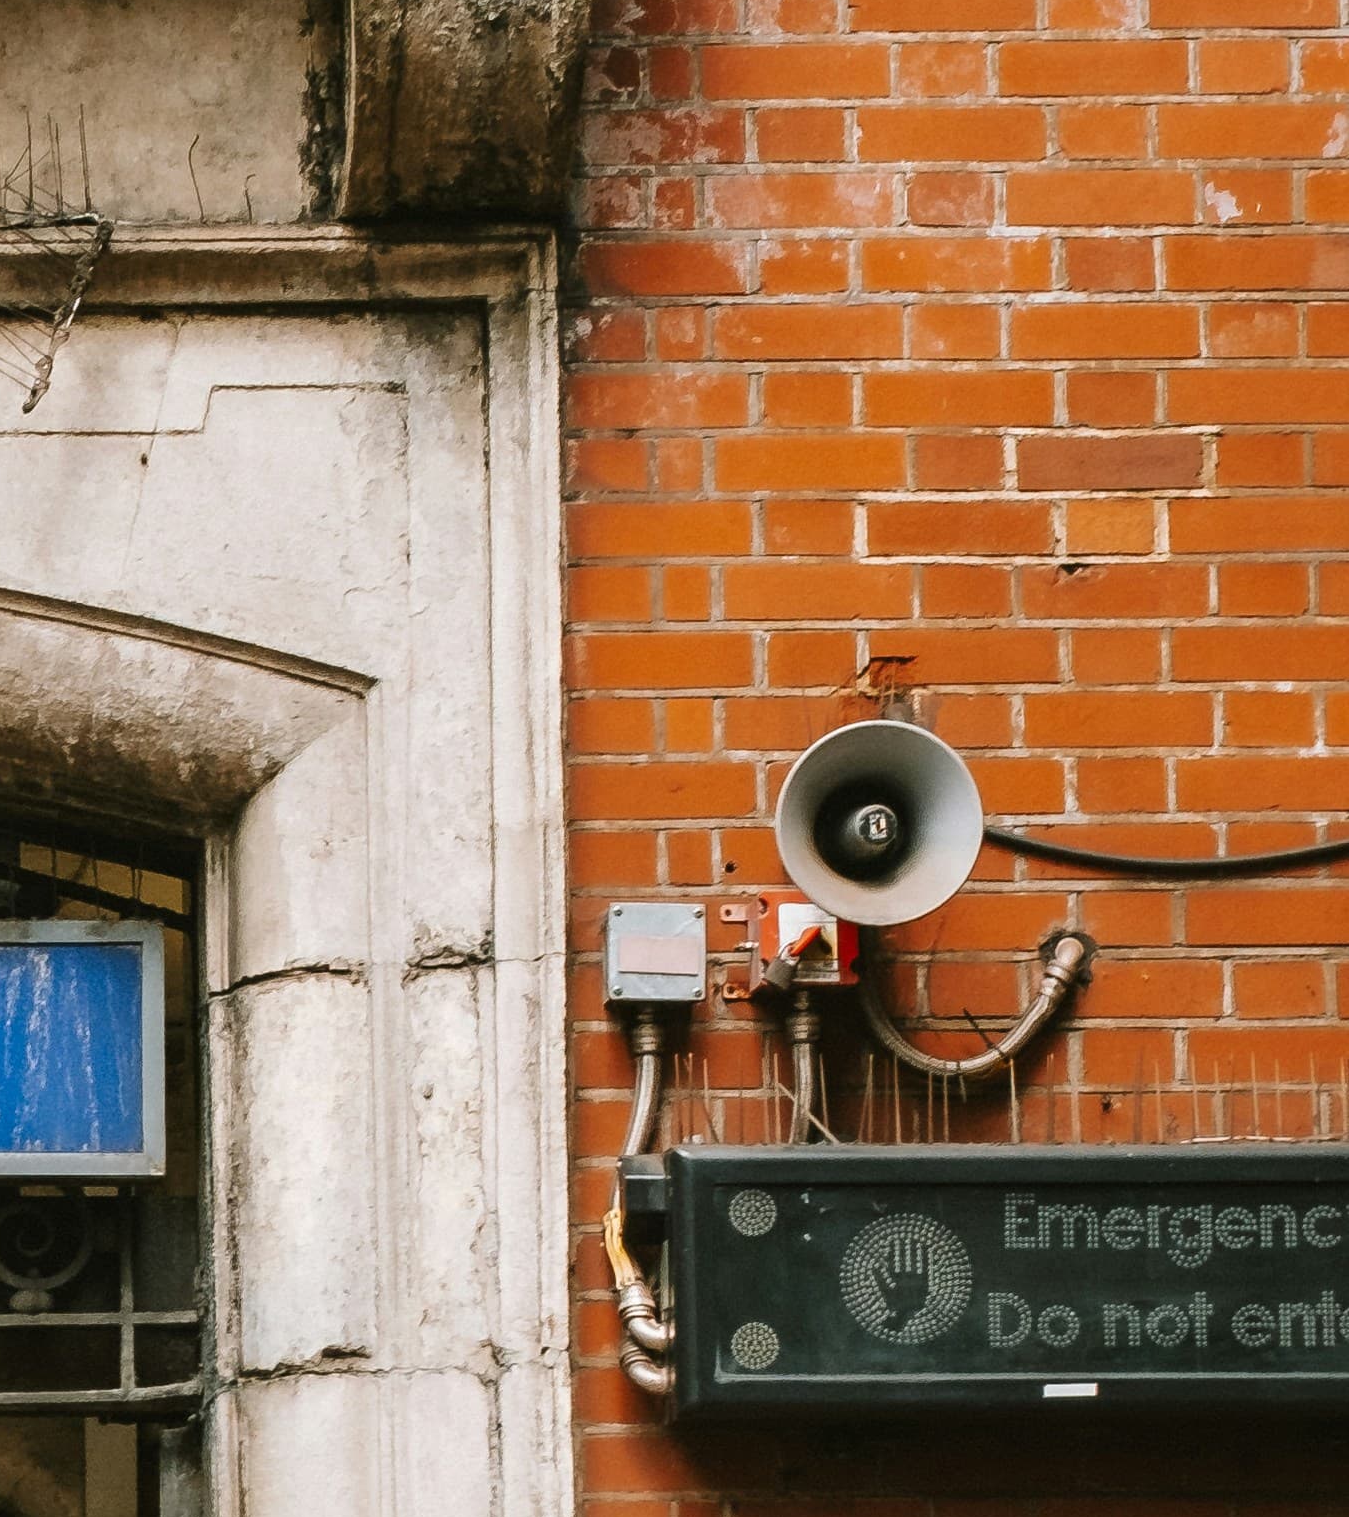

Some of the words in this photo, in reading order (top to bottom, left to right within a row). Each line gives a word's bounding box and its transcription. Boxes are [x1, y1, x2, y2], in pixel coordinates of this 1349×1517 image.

[1004, 1193, 1349, 1268] Emergenc
[988, 1292, 1080, 1348] Do
[1102, 1291, 1214, 1347] not
[1231, 1290, 1349, 1347] ent
